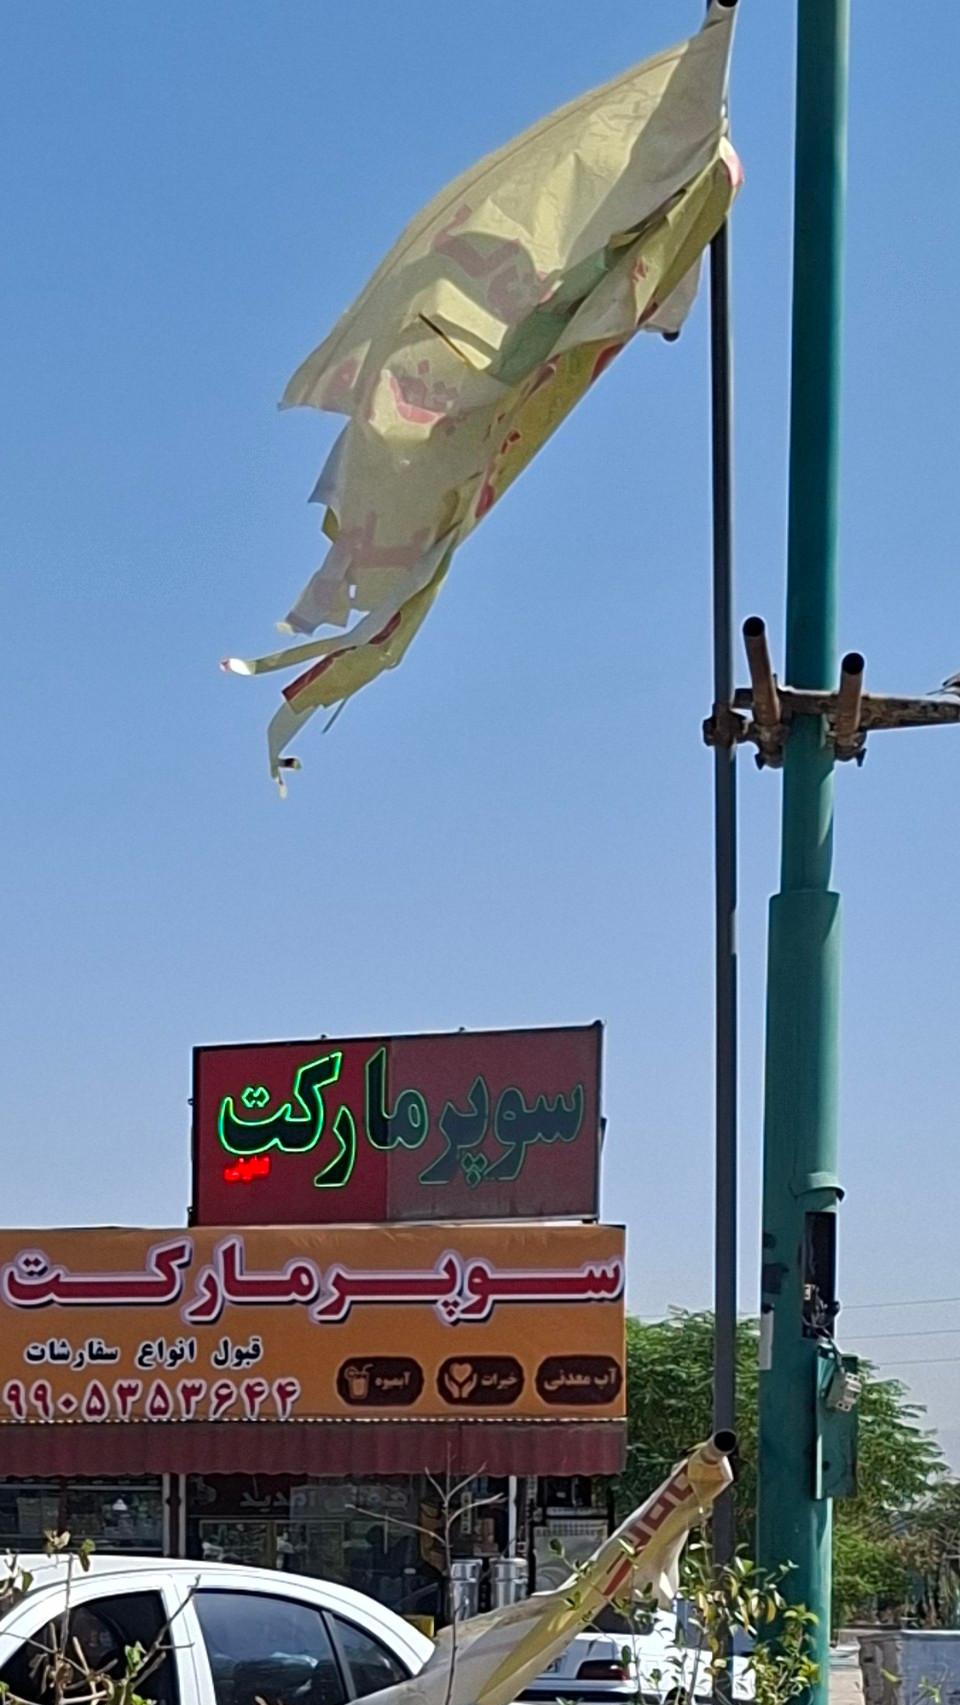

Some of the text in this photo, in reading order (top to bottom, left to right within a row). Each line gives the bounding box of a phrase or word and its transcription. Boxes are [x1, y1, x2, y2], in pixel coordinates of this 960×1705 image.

[218, 1046, 584, 1188] سوپرمارکت
[2, 1238, 623, 1324] سوپرمارکت
[25, 1336, 263, 1370] قبول انواع سفارشات
[480, 1371, 519, 1391] خیرات
[543, 1366, 618, 1391] آب معدنی
